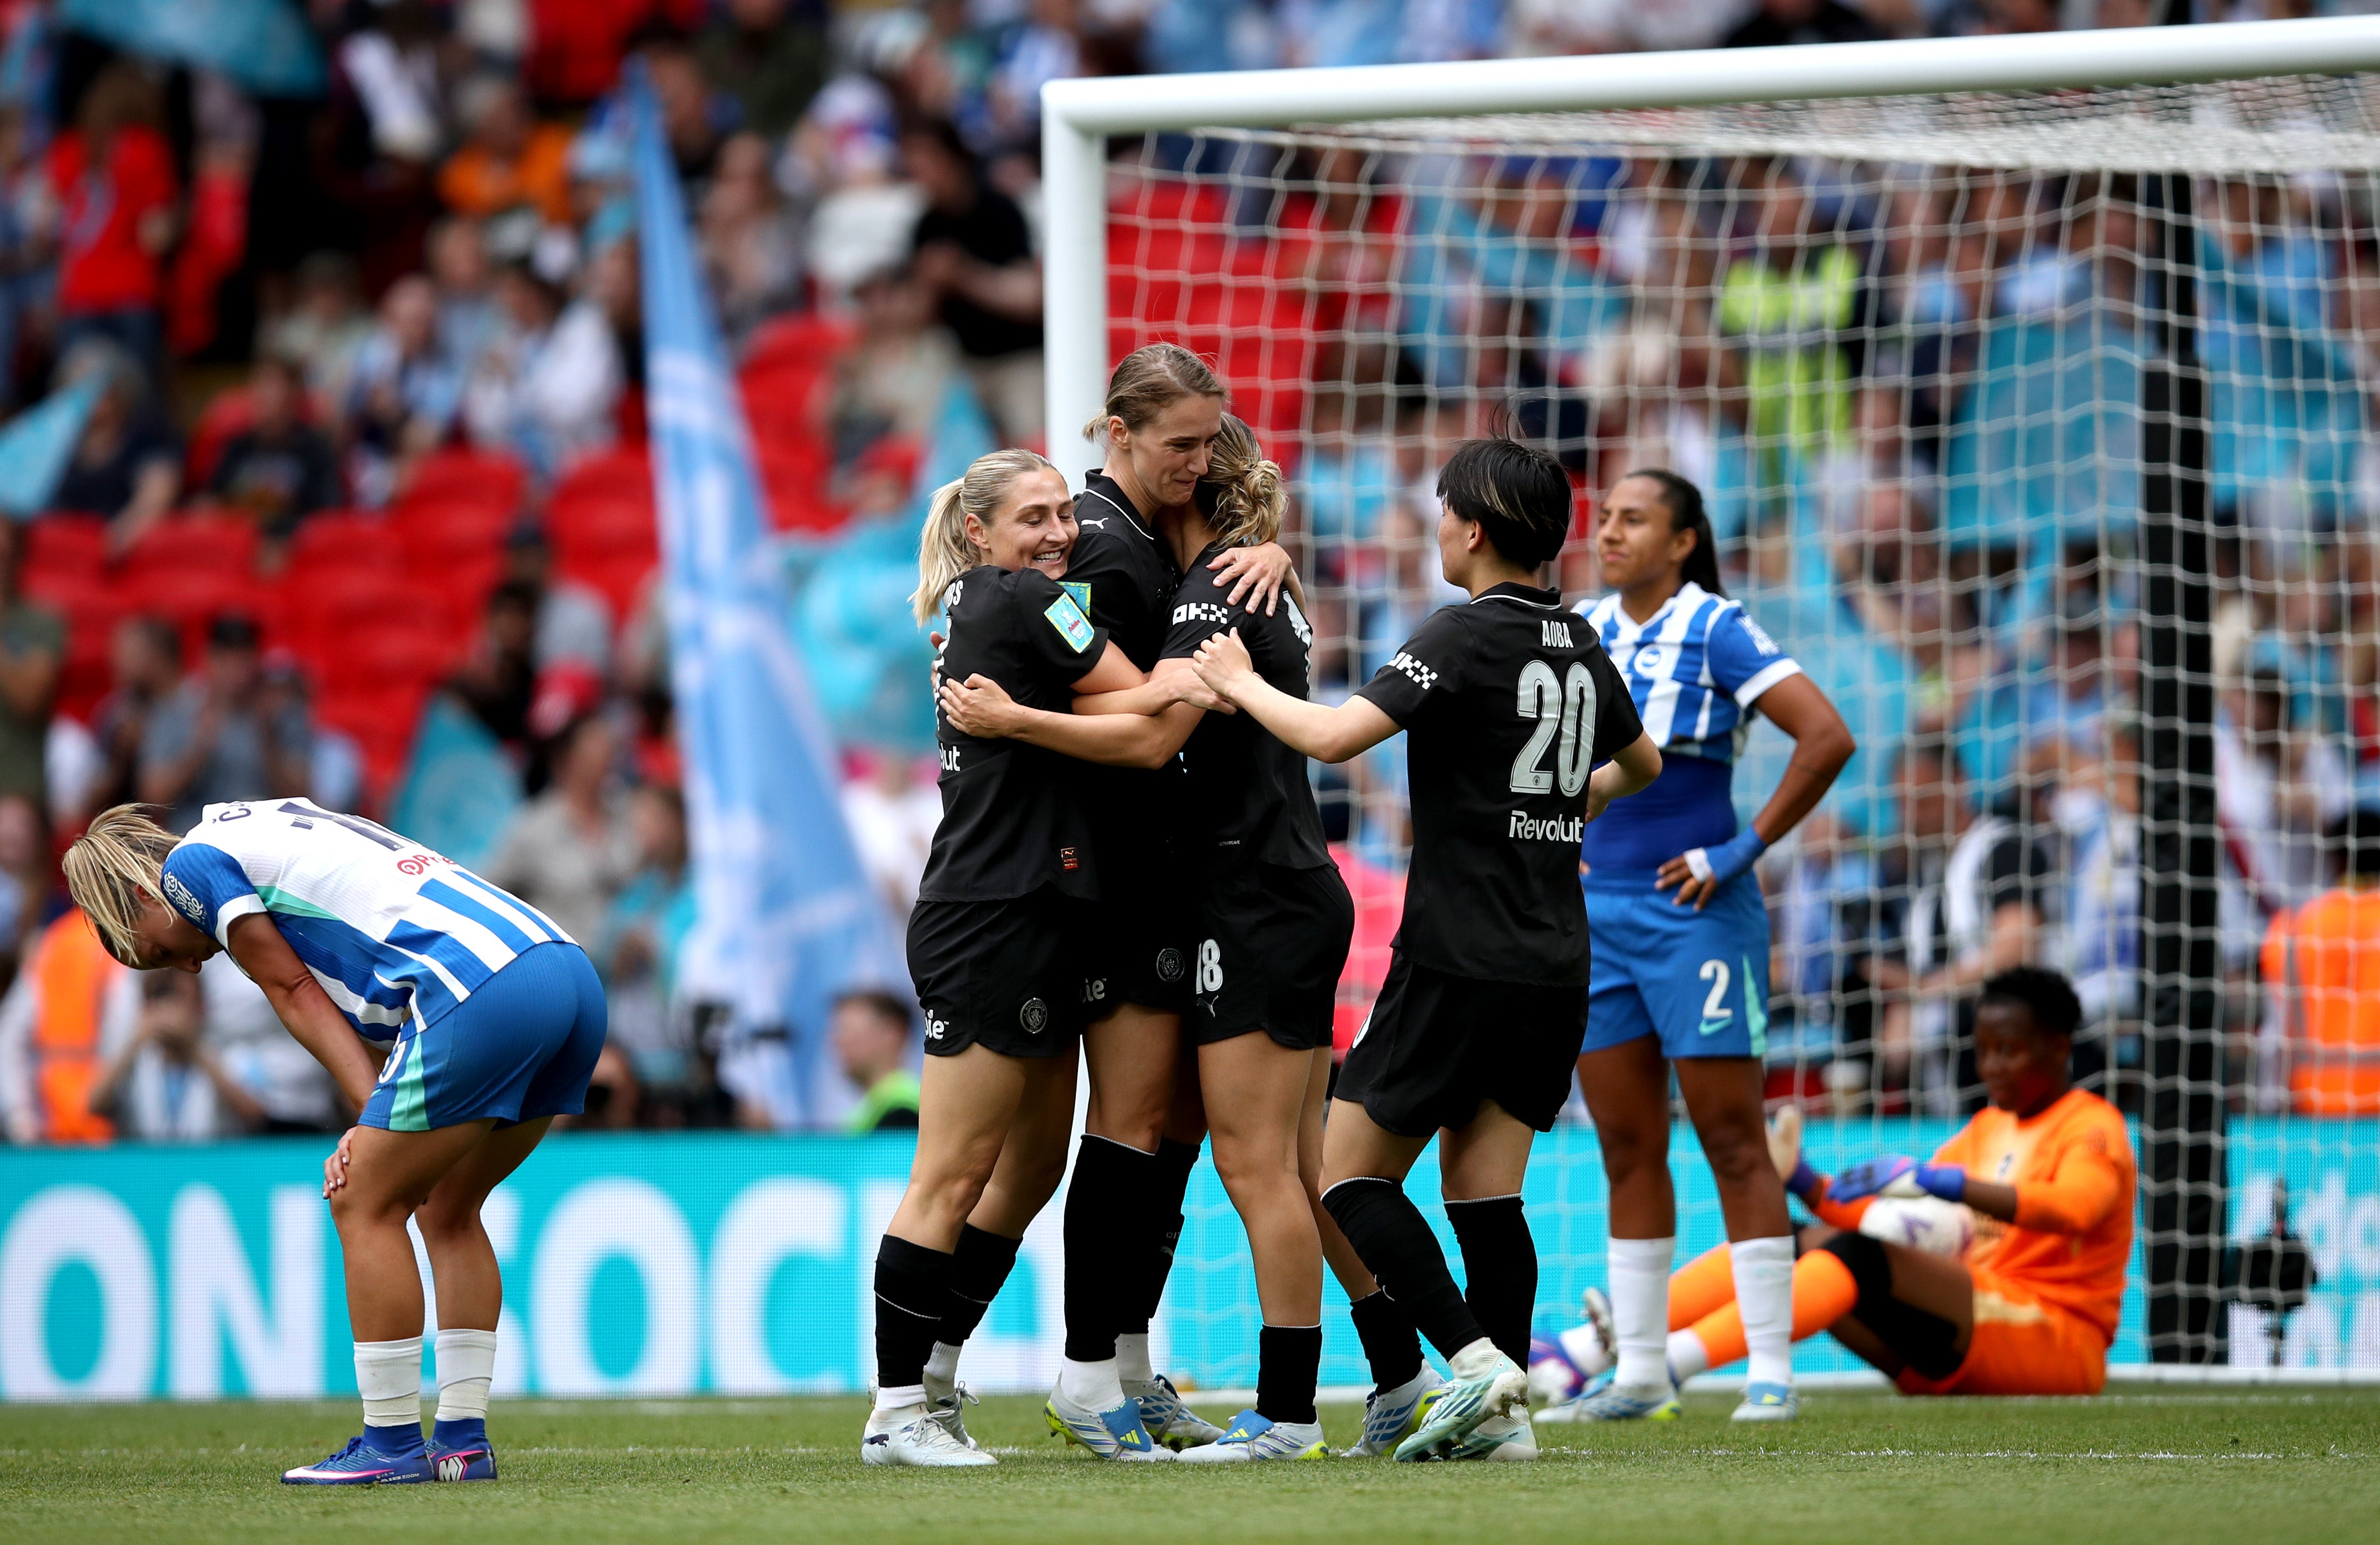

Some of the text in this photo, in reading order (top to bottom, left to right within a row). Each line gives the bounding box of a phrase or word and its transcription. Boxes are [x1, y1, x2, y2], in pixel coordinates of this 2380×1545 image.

[1541, 620, 1574, 648] AOBA
[1510, 660, 1597, 797] 20
[1509, 810, 1584, 843] Revolut
[1196, 939, 1223, 994] 18
[1699, 959, 1733, 1018] 2
